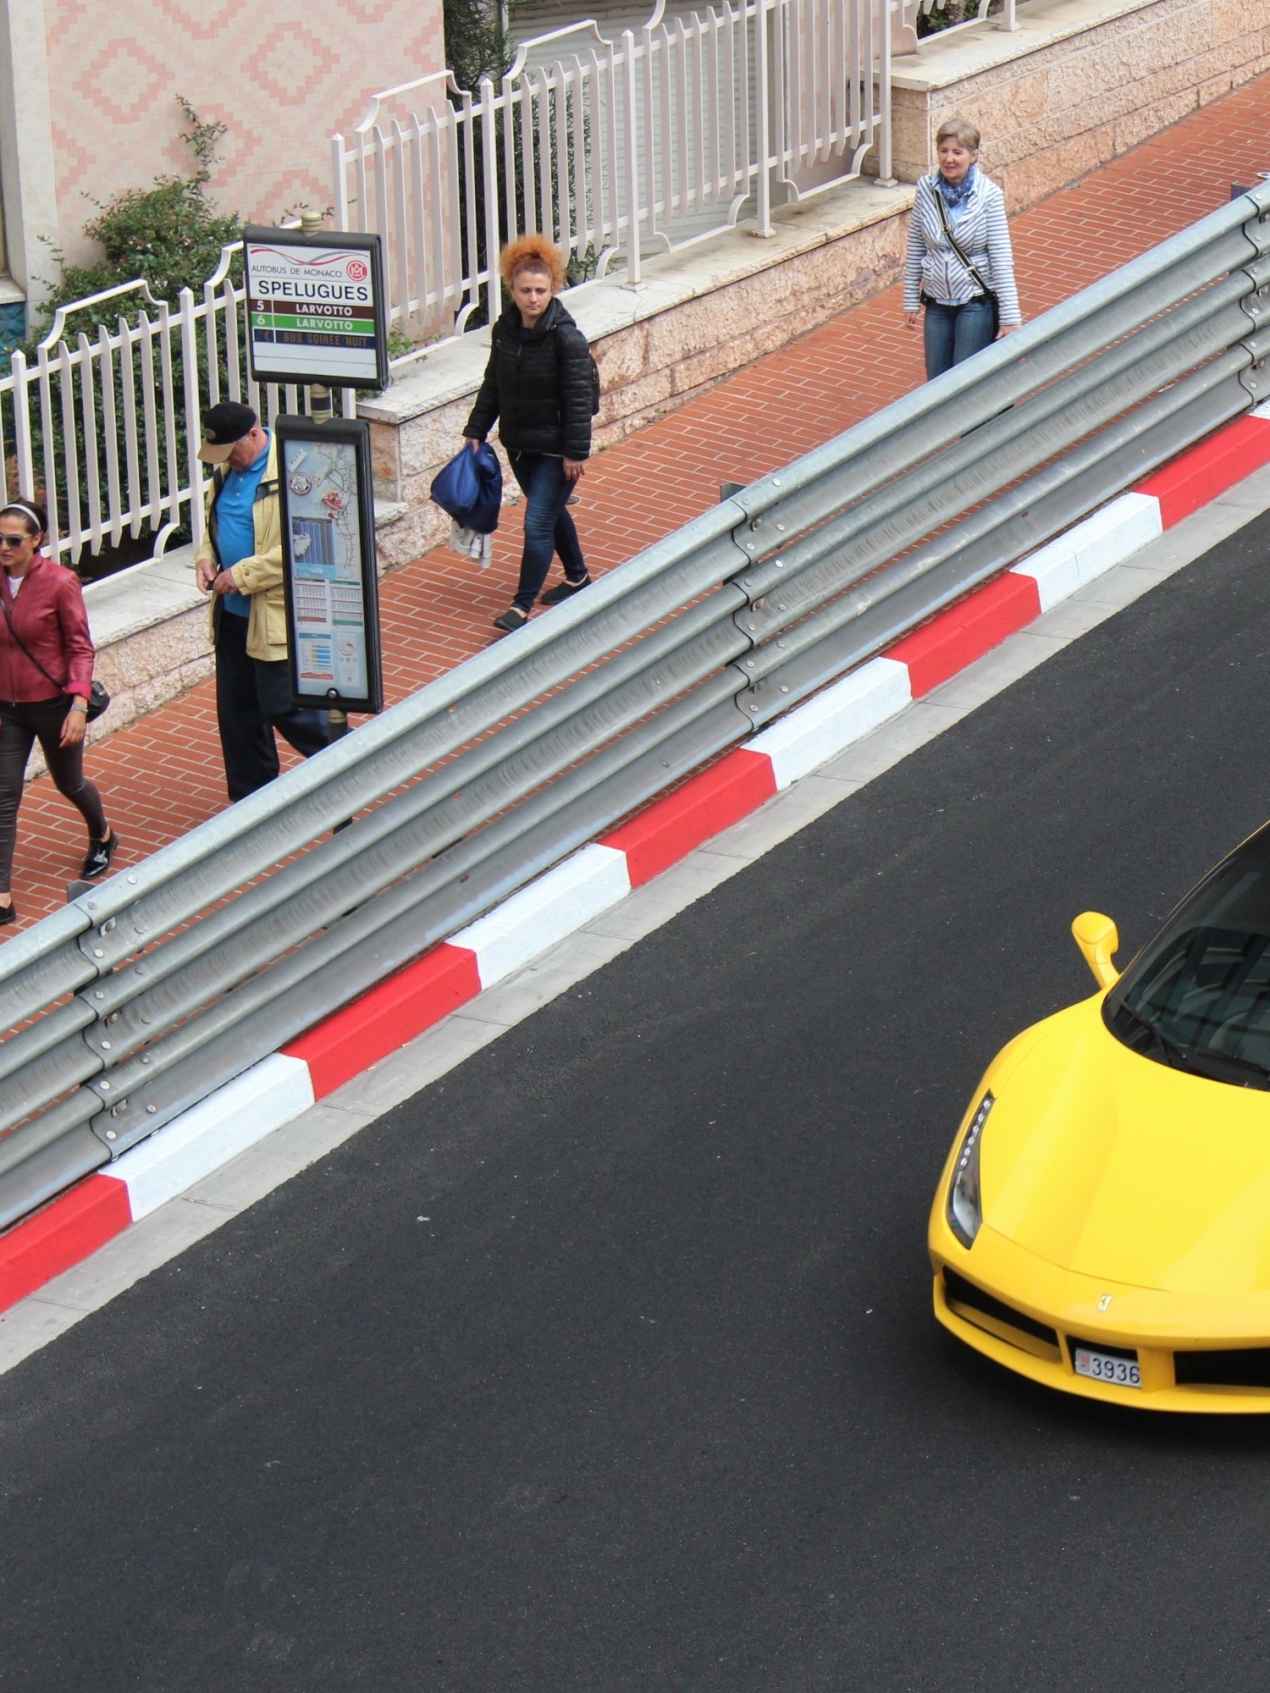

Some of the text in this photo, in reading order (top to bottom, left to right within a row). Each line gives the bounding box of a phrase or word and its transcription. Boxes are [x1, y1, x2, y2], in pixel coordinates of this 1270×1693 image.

[251, 265, 343, 279] AUTOBUS DE MONACO
[258, 280, 369, 301] SPELUGUES
[256, 300, 353, 317] 5 LARVOTTO
[257, 314, 354, 331] 6 LARVOTTO
[284, 329, 303, 342] BUS
[1092, 1357, 1140, 1384] 3936
